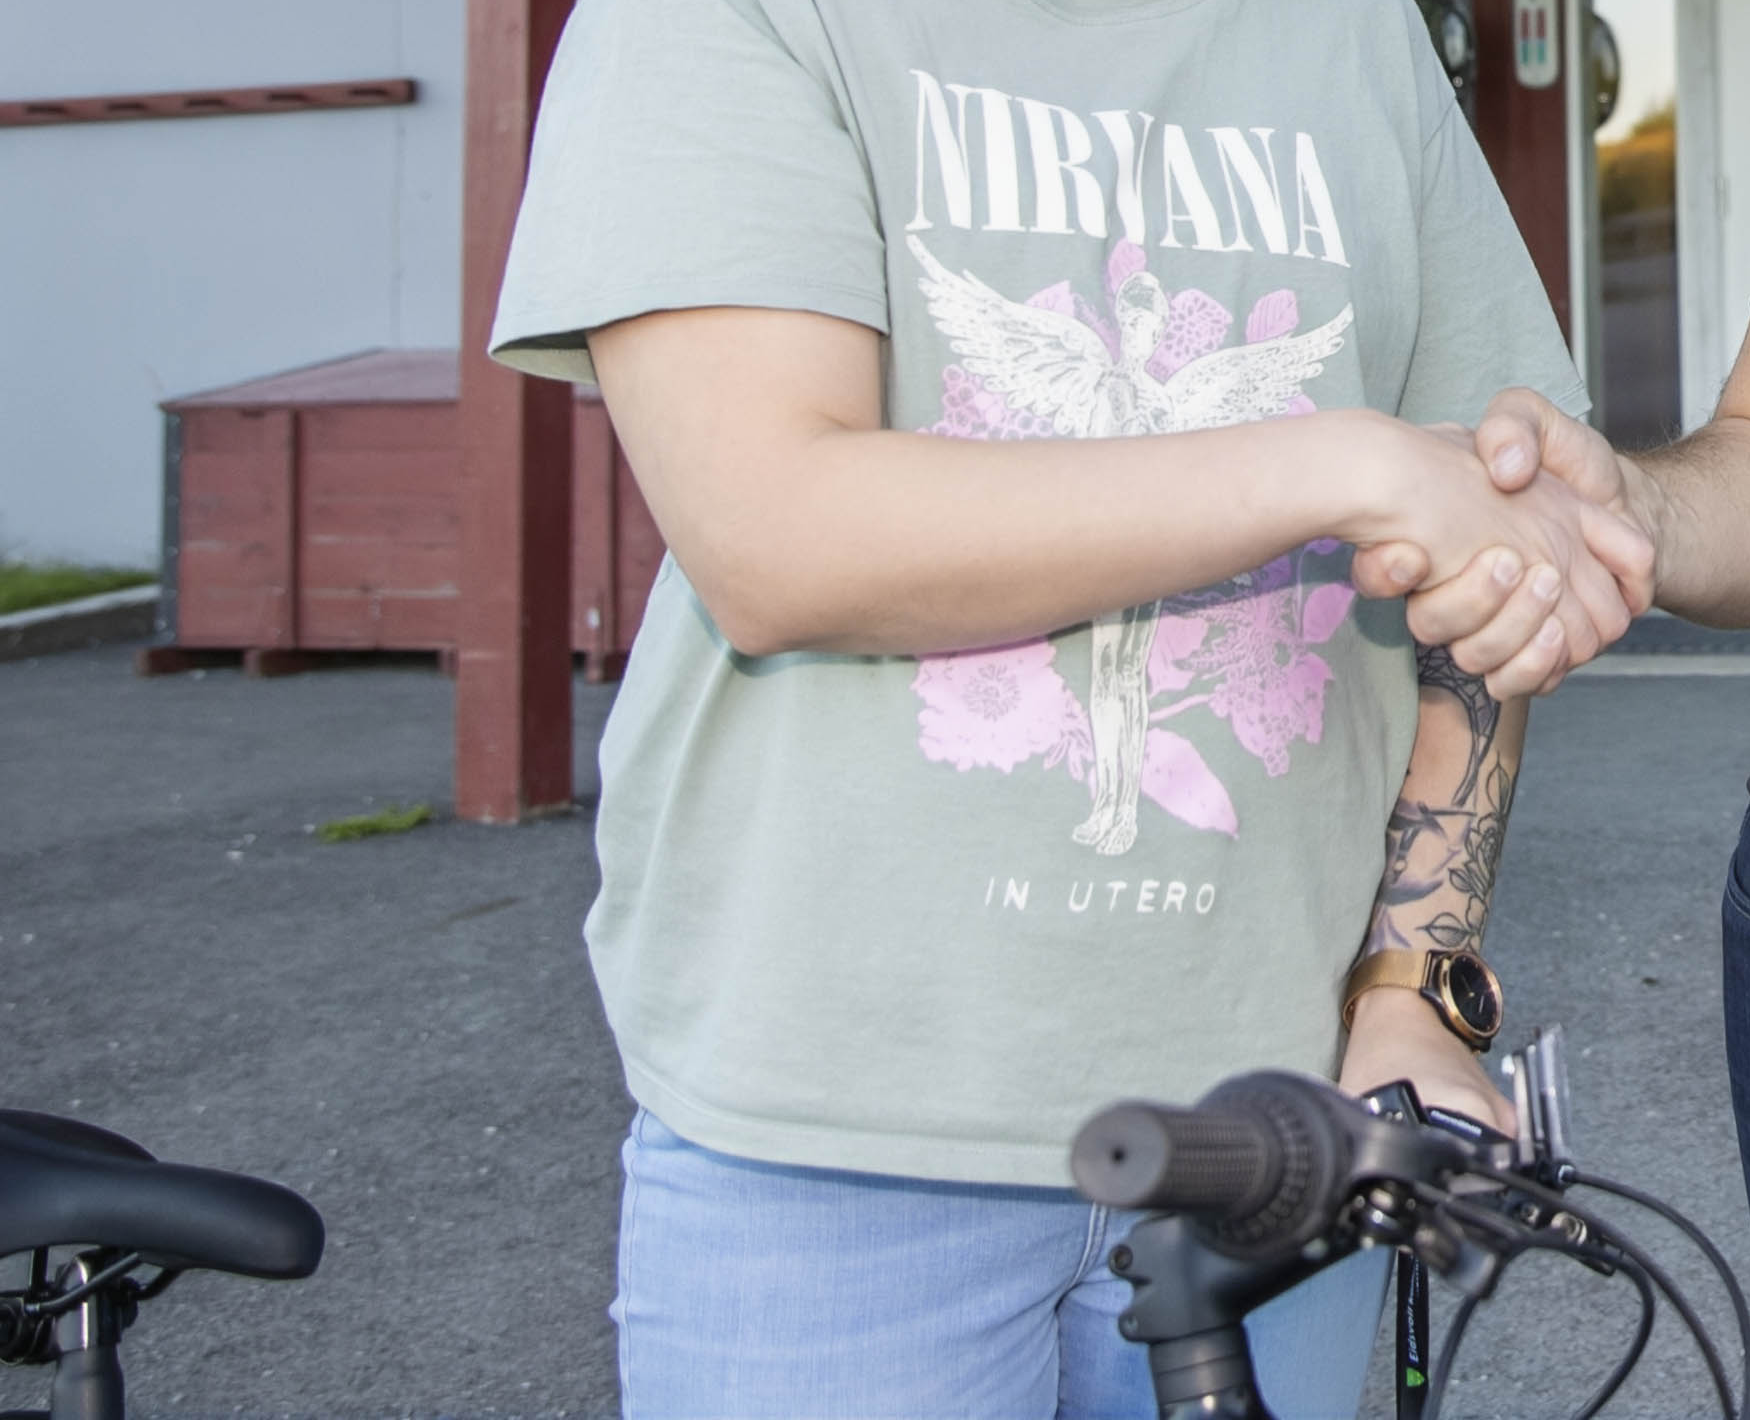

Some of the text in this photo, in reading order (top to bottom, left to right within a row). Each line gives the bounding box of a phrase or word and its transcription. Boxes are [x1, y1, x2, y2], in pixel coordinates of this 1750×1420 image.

[904, 68, 1352, 268] NIRVANA
[984, 876, 1217, 915] IN UTERO
